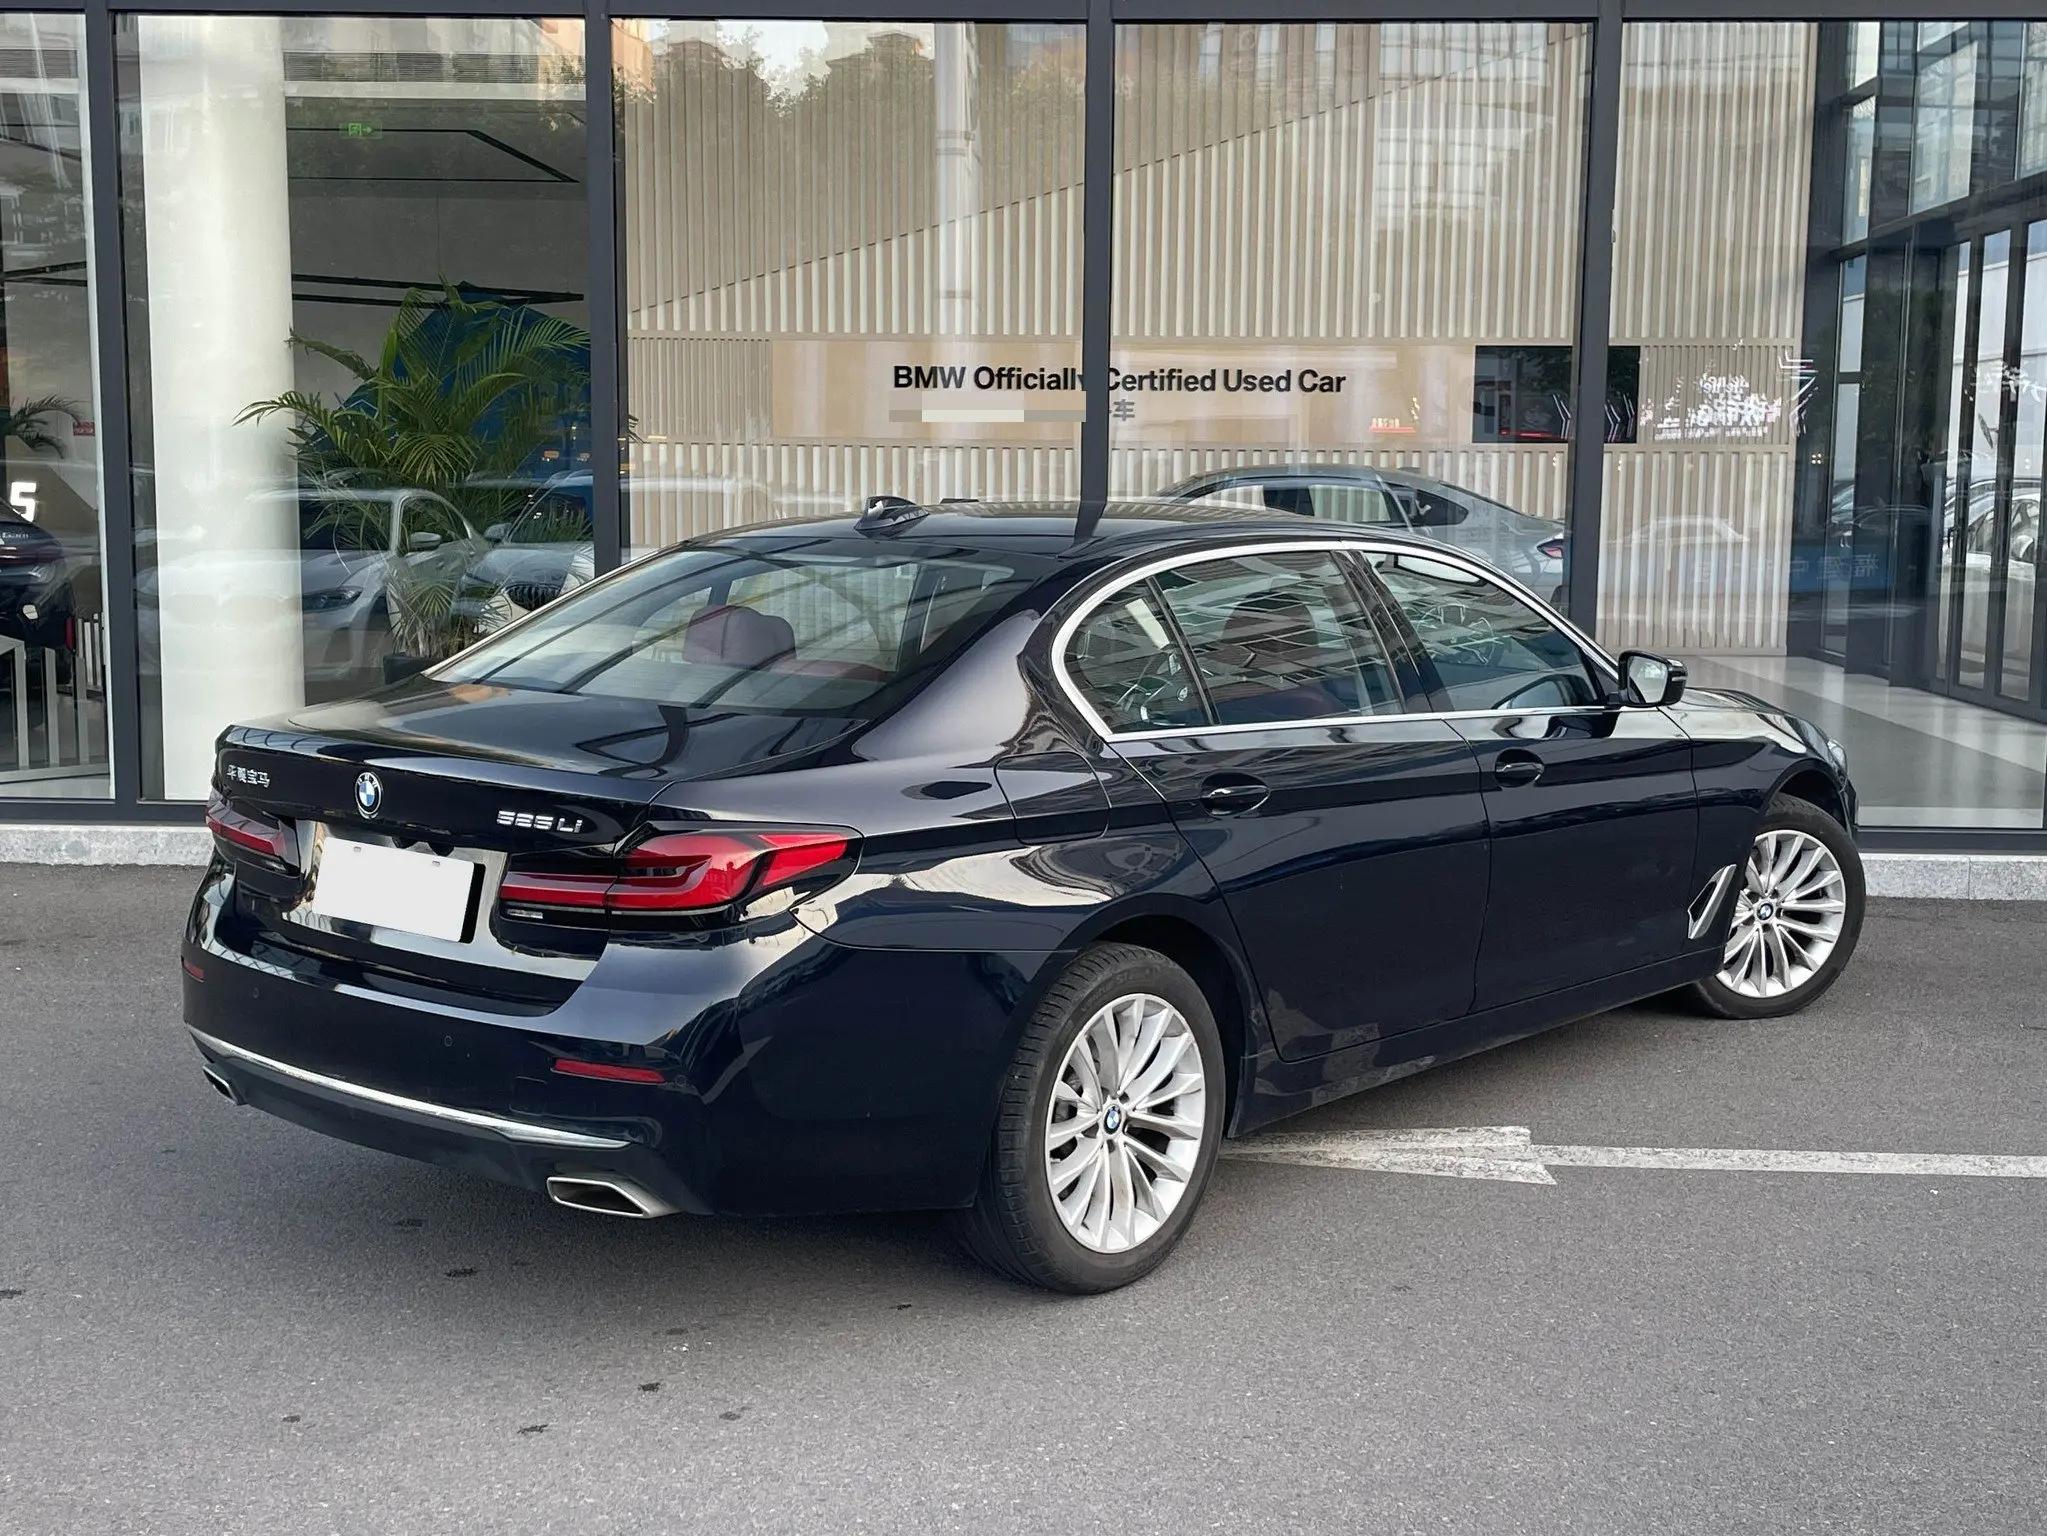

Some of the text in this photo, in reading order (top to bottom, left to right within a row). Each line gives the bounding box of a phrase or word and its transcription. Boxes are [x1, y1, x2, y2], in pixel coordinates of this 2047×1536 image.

[893, 365, 966, 389] BMW
[1109, 367, 1217, 392] Certified
[1223, 368, 1292, 393] Used
[1299, 369, 1347, 393] Car
[1109, 399, 1136, 421] 车
[10, 481, 37, 523] 5
